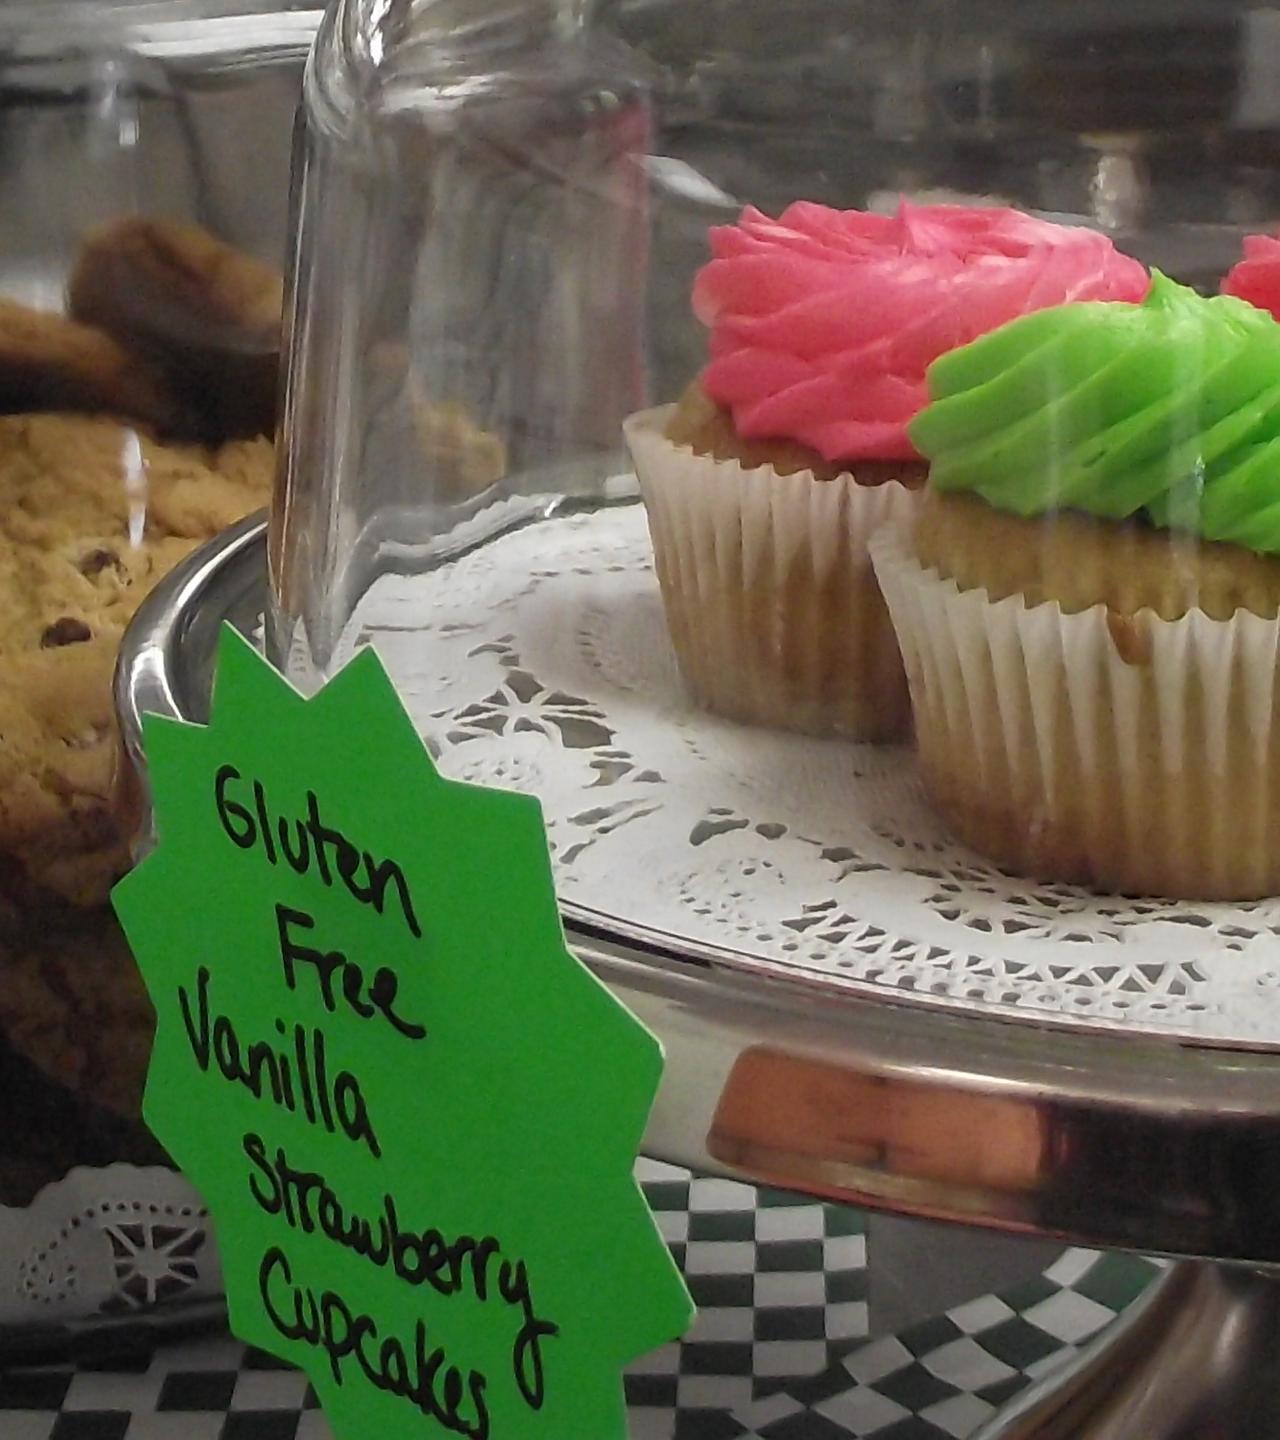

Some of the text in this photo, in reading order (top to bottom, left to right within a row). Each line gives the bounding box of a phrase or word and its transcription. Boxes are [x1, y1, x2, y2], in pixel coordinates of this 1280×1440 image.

[214, 764, 423, 939] Gluten
[177, 965, 383, 1158] Vanilla
[274, 902, 427, 1040] Free
[242, 1132, 560, 1411] Strawberry
[257, 1246, 490, 1440] Cupcakes
